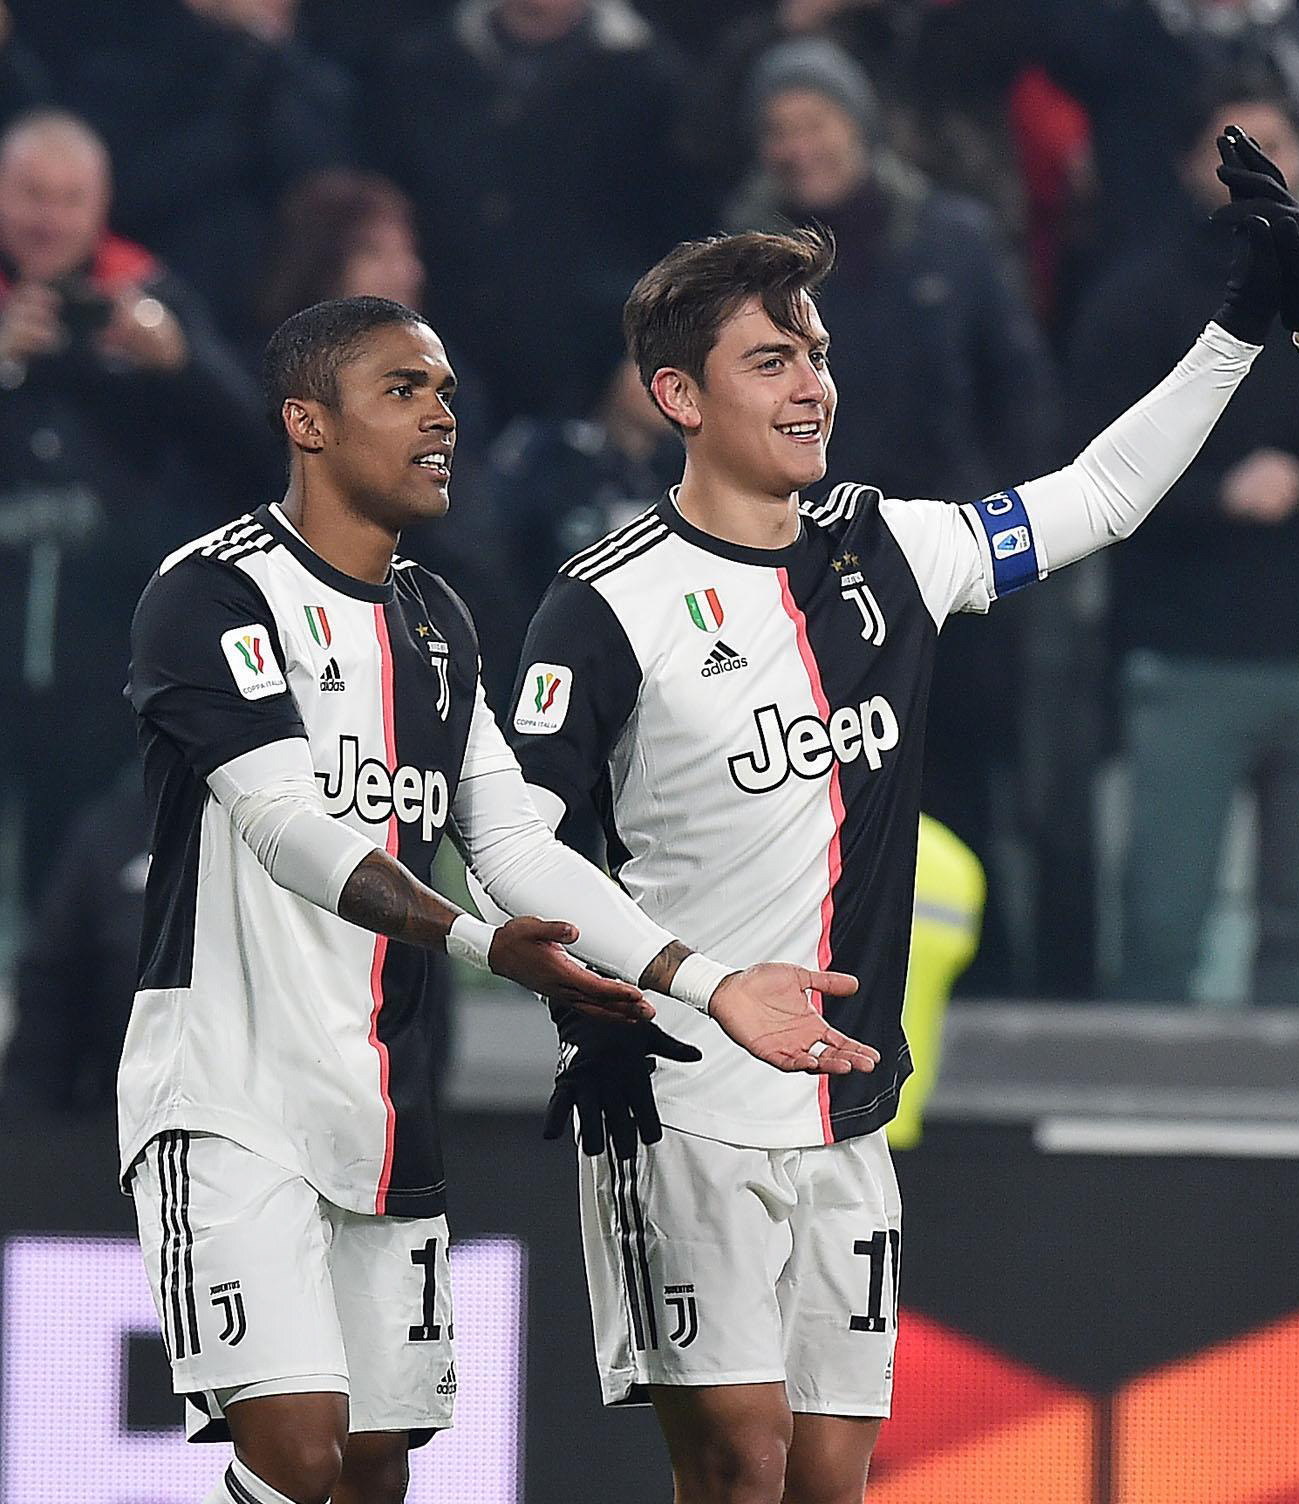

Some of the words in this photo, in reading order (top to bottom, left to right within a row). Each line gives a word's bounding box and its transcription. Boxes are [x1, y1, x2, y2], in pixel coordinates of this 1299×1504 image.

[320, 677, 345, 692] adidas
[700, 657, 748, 678] adidas
[315, 735, 449, 842] Jeep
[727, 694, 900, 794] Jeep
[408, 1237, 454, 1341] 1
